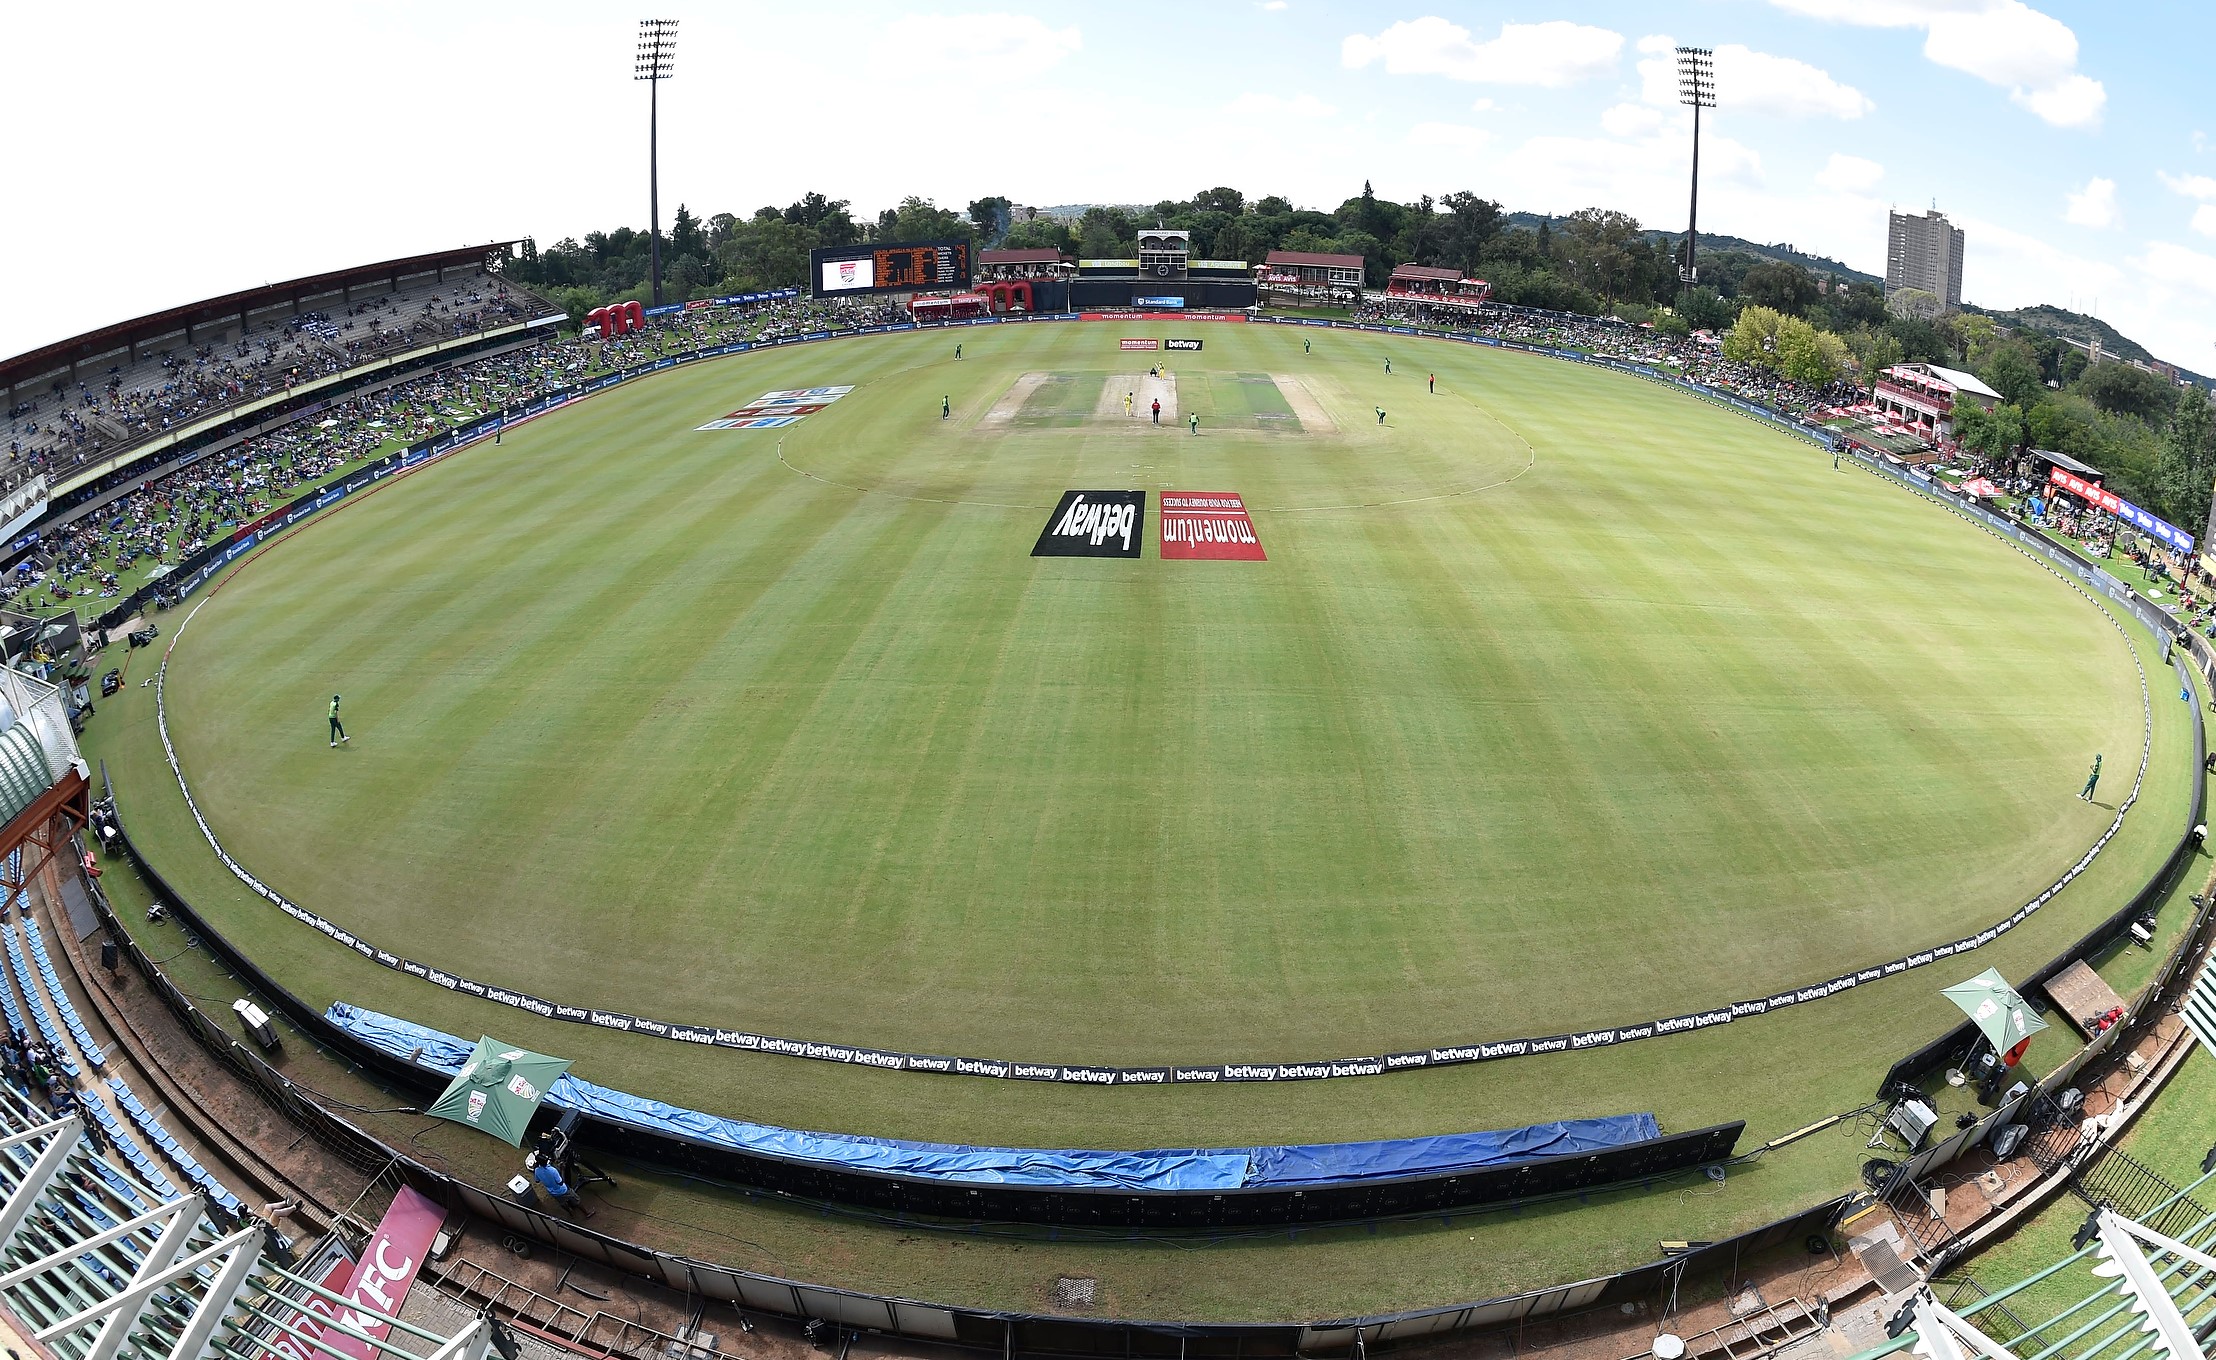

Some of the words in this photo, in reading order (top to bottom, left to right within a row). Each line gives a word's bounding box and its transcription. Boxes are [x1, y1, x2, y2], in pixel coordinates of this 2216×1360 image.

[1169, 340, 1199, 349] betway
[2052, 471, 2067, 484] AVIS
[2069, 479, 2084, 492] AVIS
[2085, 487, 2100, 500] AVIS
[2102, 495, 2117, 510] AVIS
[1163, 498, 1181, 507] SUCCESS
[1182, 498, 1188, 507] TO
[1189, 498, 1208, 507] JOURNEY
[1052, 494, 1136, 550] betway
[1164, 519, 1256, 548] momentum
[1997, 920, 2010, 933] betway
[334, 929, 355, 947] betway
[1978, 929, 1996, 944] betway
[355, 941, 373, 957] betway
[1934, 946, 1953, 957] betway
[1955, 938, 1977, 953] betway
[378, 950, 398, 966] betway
[1909, 953, 1932, 967] betway
[404, 962, 426, 977] betway
[1858, 968, 1880, 981] betway
[1885, 962, 1906, 974] betway
[429, 969, 457, 989] betway
[1828, 976, 1855, 993] betway
[460, 979, 485, 995] betway
[1798, 986, 1828, 1001] betway
[488, 988, 521, 1006] betway
[1769, 994, 1795, 1007] betway
[521, 996, 553, 1016] betway
[557, 1005, 587, 1020] betway
[1732, 1000, 1766, 1016] betway
[592, 1012, 631, 1030] betway
[635, 1018, 667, 1034] betway
[1657, 1017, 1694, 1032] betway
[1696, 1012, 1732, 1027] betway
[672, 1028, 716, 1044] betway
[716, 1030, 760, 1047] betway
[1573, 1030, 1615, 1047] betway
[1620, 1026, 1652, 1040] betway
[761, 1037, 806, 1055] betway
[807, 1043, 853, 1062] betway
[1482, 1041, 1527, 1057] betway
[1532, 1038, 1567, 1052] betway
[855, 1050, 903, 1069] betway
[1388, 1053, 1427, 1067] betway
[1433, 1047, 1480, 1061] betway
[909, 1057, 950, 1070] betway
[957, 1059, 1007, 1077] betway
[1015, 1065, 1057, 1079] betway
[1063, 1068, 1115, 1084] betway
[1123, 1071, 1165, 1083] betway
[1177, 1070, 1219, 1081] betway
[1225, 1065, 1277, 1080] betway
[1280, 1065, 1330, 1078] betway
[340, 1238, 413, 1351] KFC
